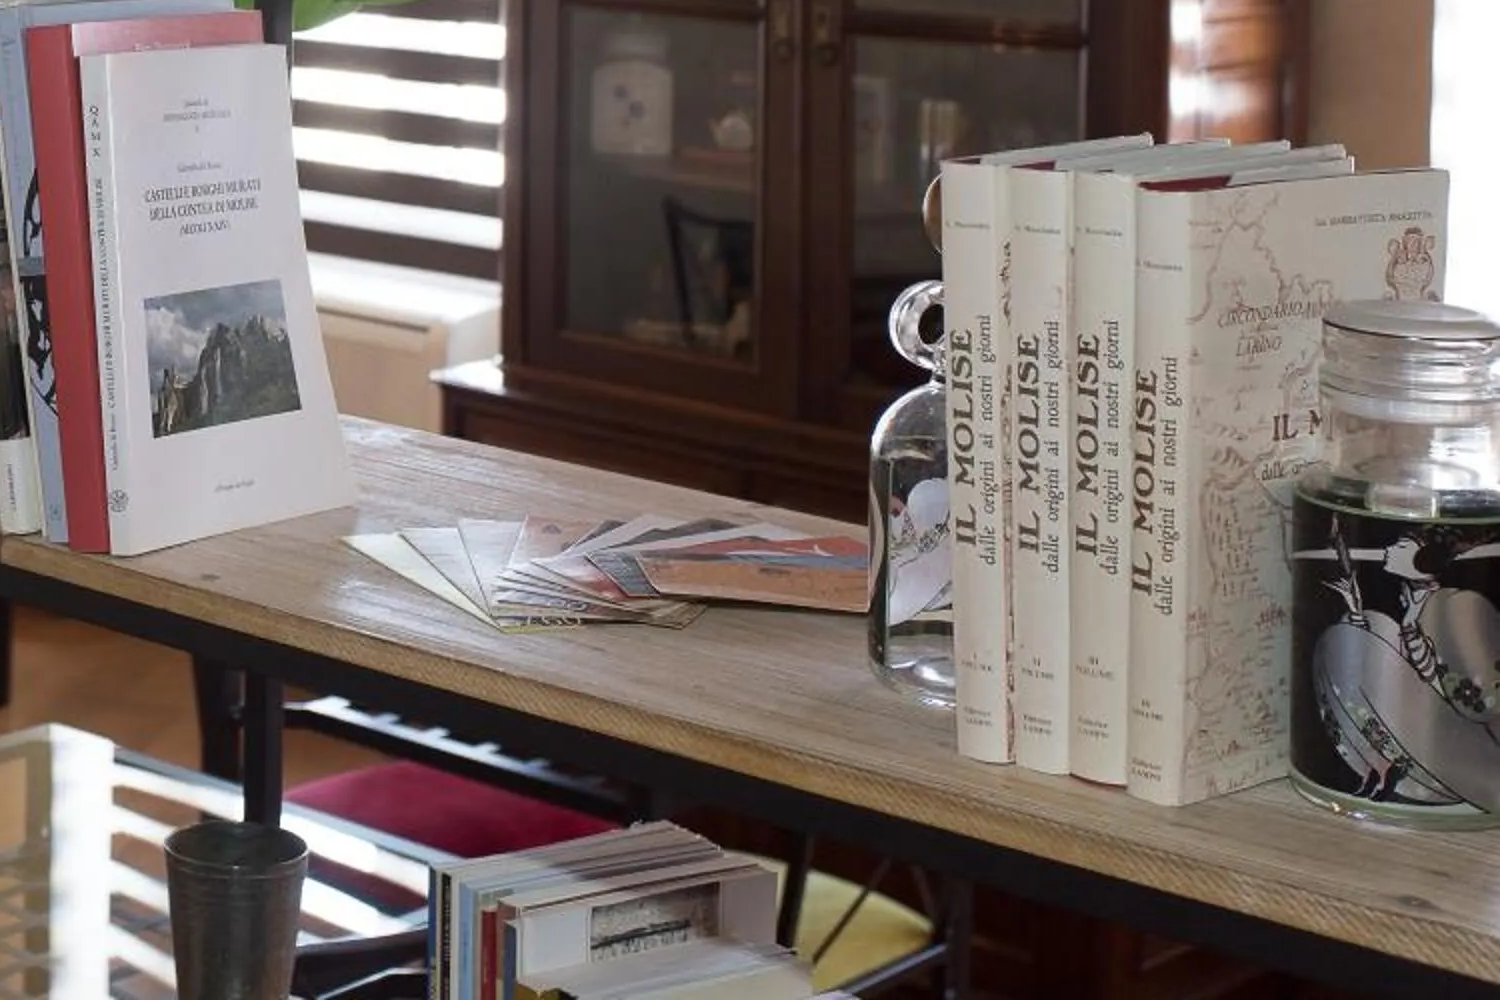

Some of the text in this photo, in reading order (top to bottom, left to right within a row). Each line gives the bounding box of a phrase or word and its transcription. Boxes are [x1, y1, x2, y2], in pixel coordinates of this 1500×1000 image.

[951, 328, 977, 546] IL MOLISE
[976, 314, 998, 566] dalle origini ai nostri giorni
[1017, 334, 1041, 554] IL MOLISE
[1041, 320, 1064, 573] dalle origini ai nostri giorni
[1075, 333, 1100, 556] IL MOLISE
[1100, 320, 1124, 575] dalle origini ai nostri giorni
[1132, 368, 1158, 596] IL MOLISE
[1153, 356, 1182, 616] dalle origini ai nostri giorni
[1273, 413, 1298, 442] IL
